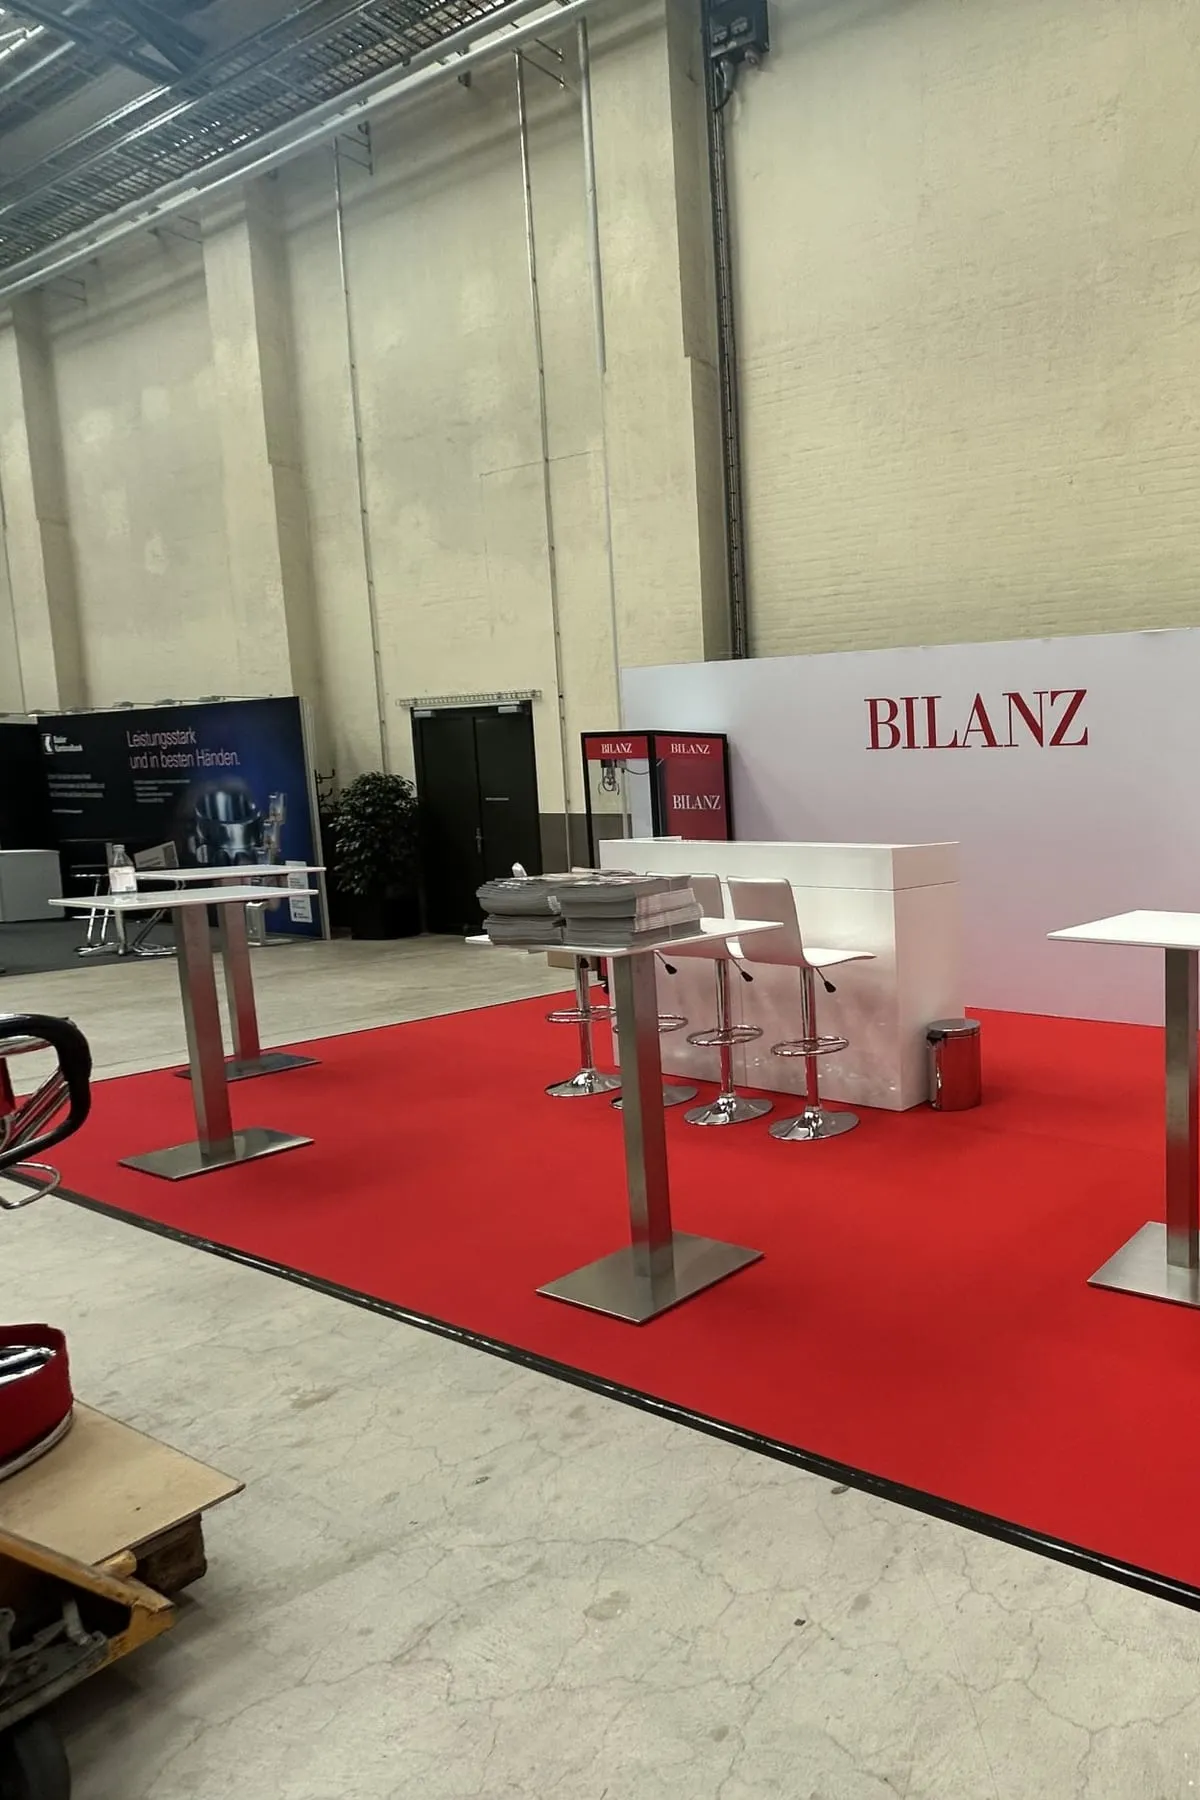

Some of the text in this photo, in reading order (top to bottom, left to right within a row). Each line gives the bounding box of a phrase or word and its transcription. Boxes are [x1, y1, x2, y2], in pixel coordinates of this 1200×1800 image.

[864, 688, 1090, 751] BILANZ
[126, 728, 197, 749] Leistungsstark
[600, 742, 633, 755] BILANZ
[670, 743, 710, 756] BILANZ
[130, 748, 241, 769] und in besten Händen.
[672, 794, 721, 810] BILANZ
